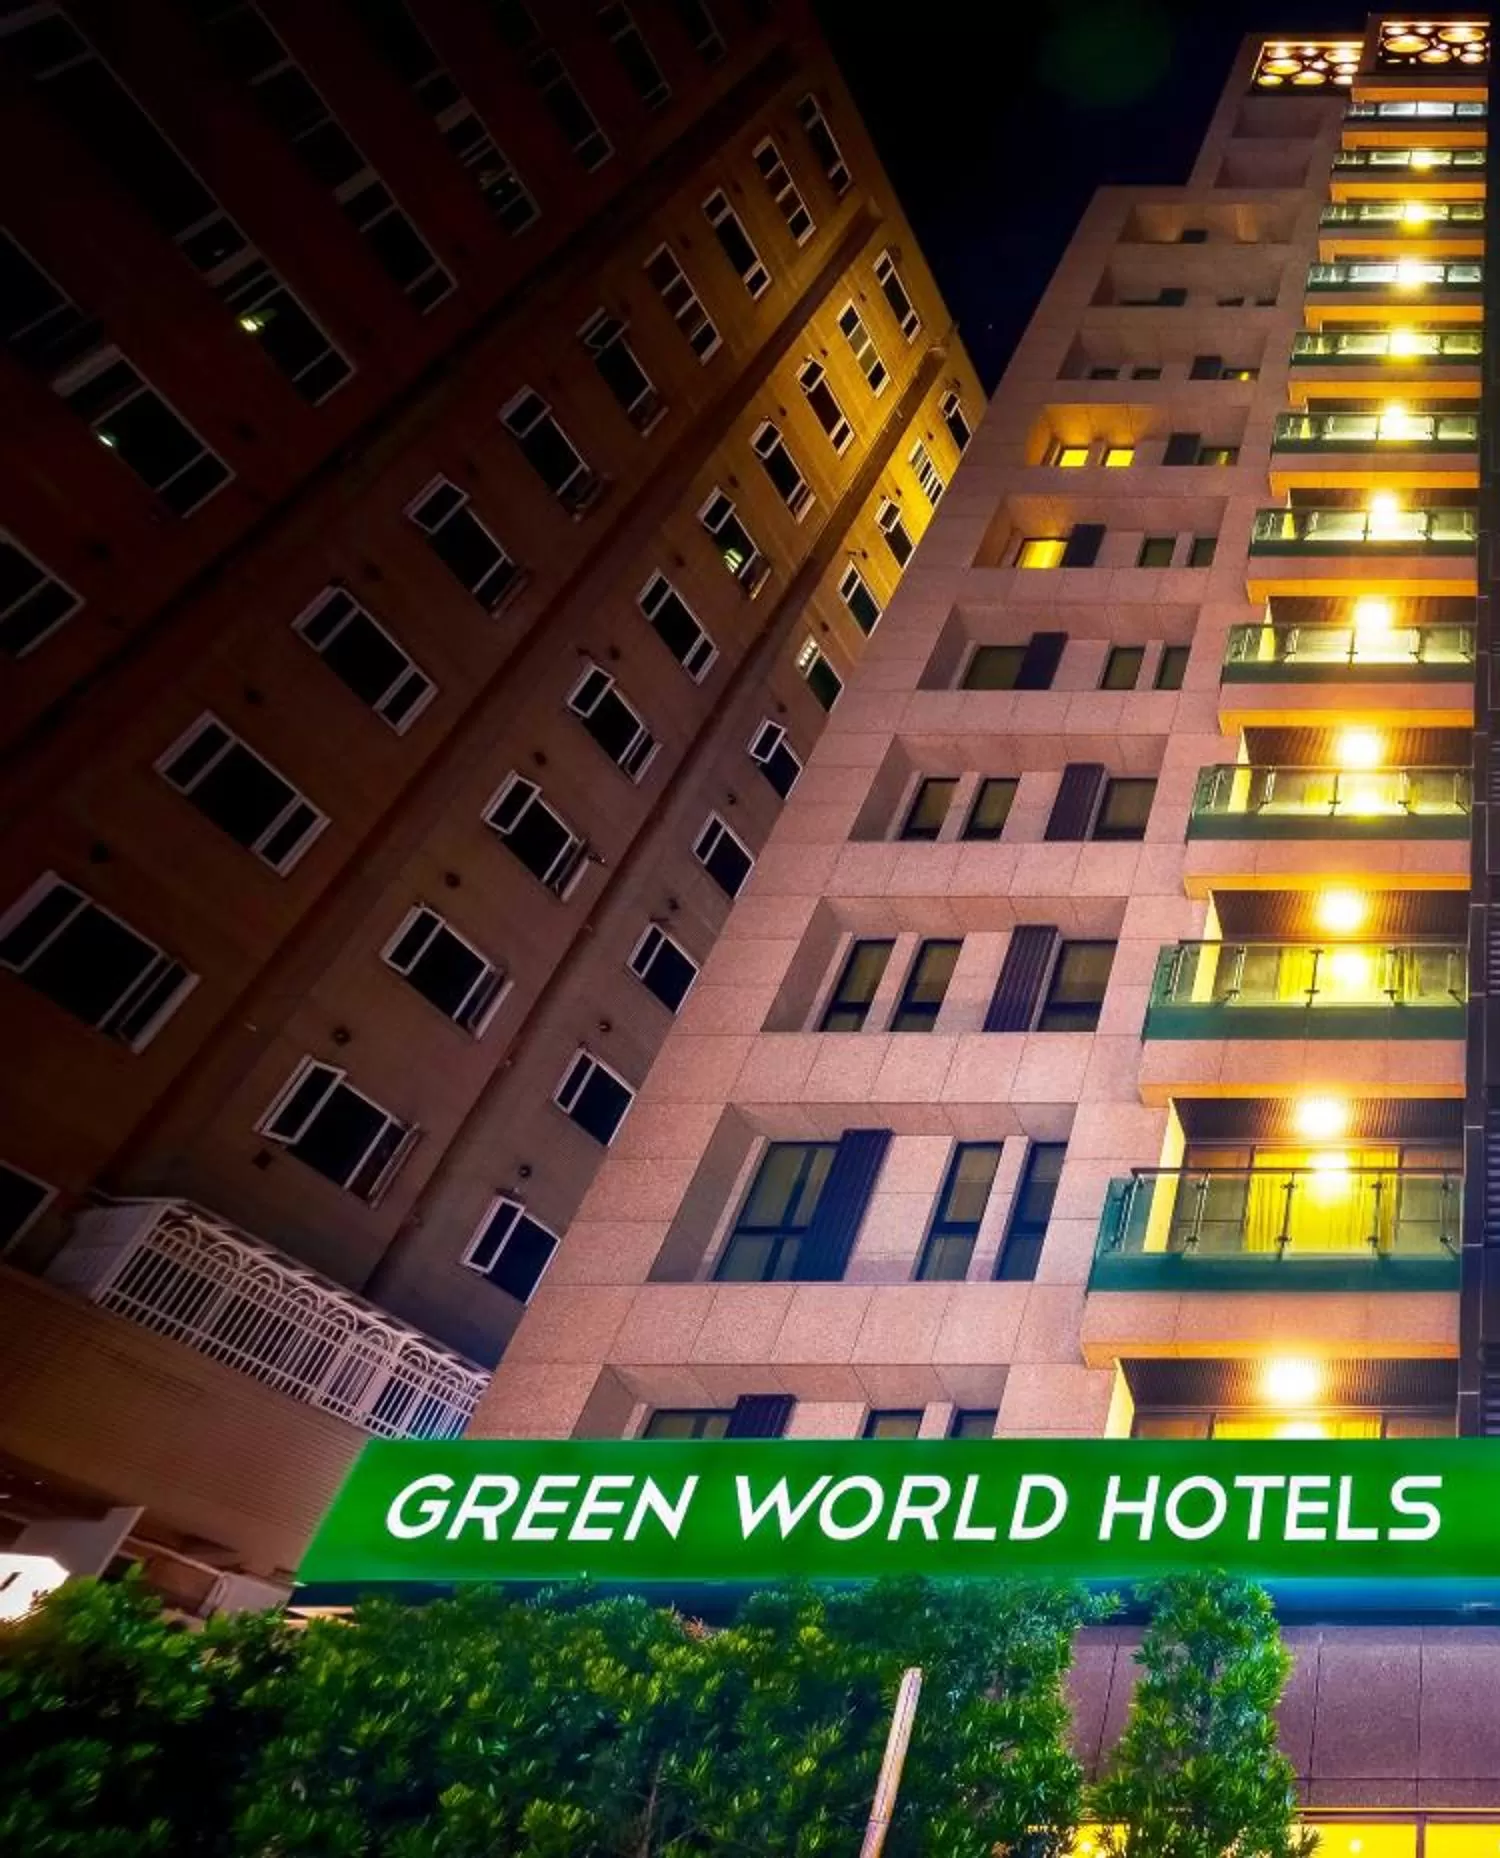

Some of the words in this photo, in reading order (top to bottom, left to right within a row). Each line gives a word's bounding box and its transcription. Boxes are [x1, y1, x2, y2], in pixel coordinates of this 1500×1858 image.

[386, 1473, 699, 1541] GREEN
[735, 1473, 1068, 1541] WORLD
[1098, 1474, 1443, 1542] HOTELS
